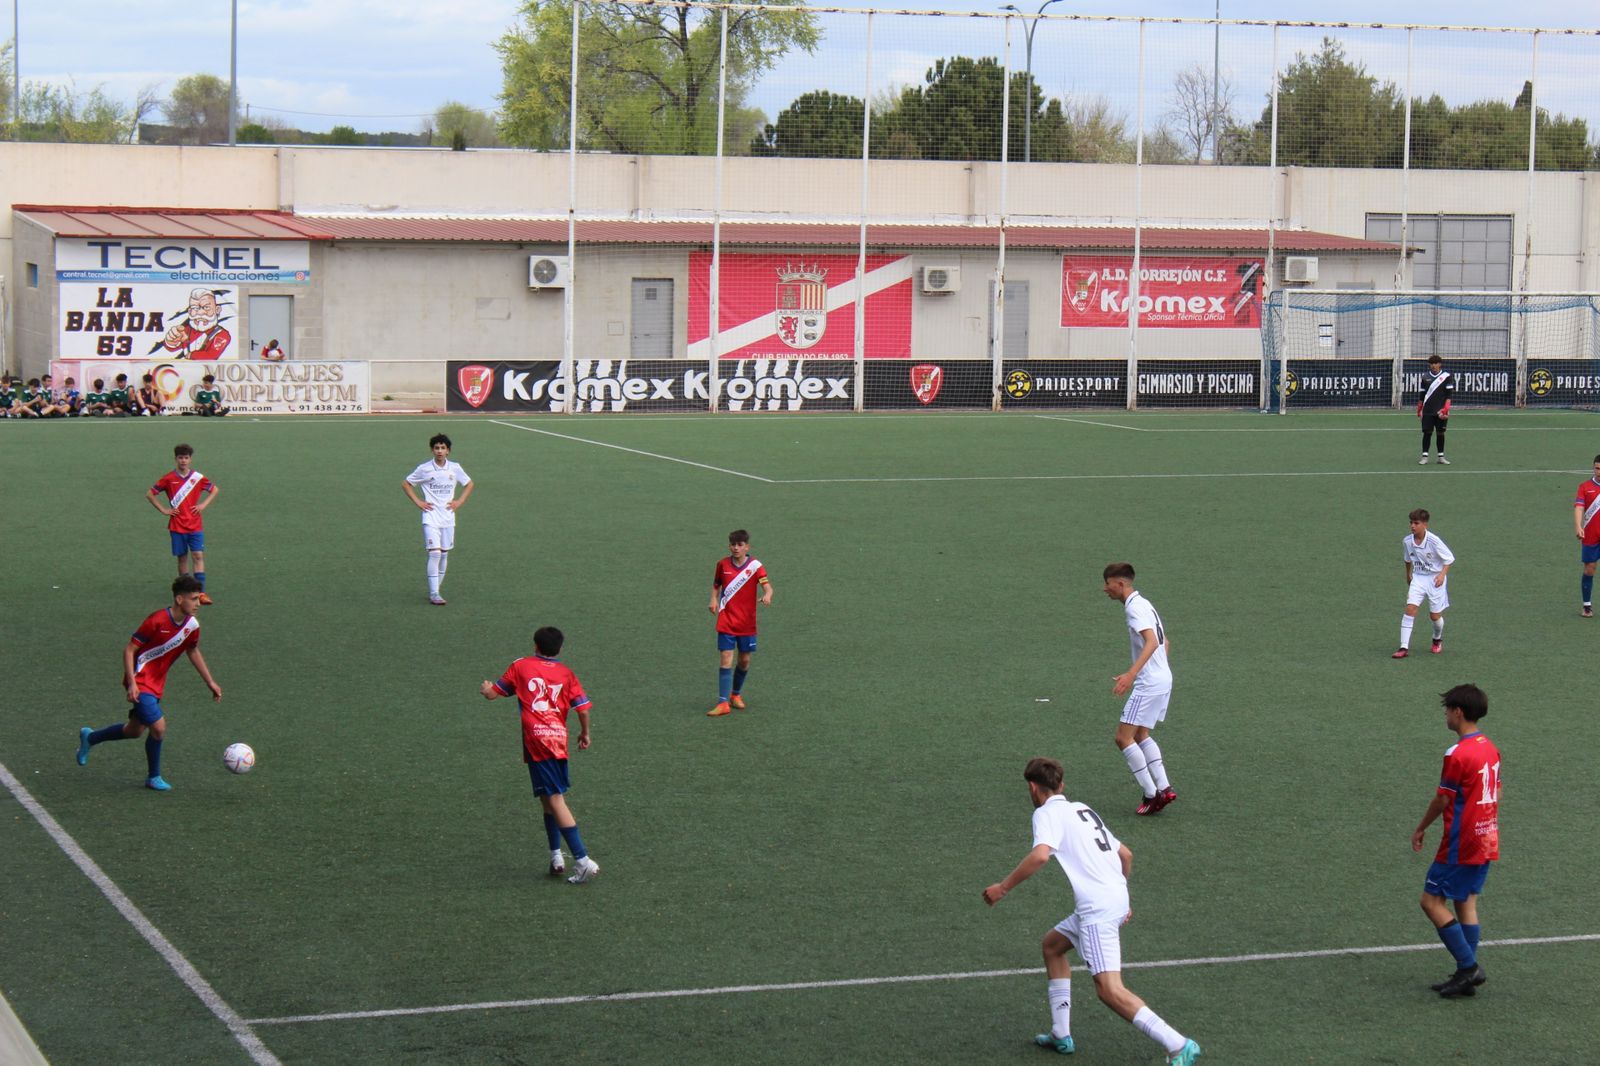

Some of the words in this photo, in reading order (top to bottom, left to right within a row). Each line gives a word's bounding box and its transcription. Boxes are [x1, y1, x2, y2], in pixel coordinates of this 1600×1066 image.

[87, 241, 280, 270] TECNEL
[62, 271, 150, 280] central.tecnel@gmail.com
[170, 270, 280, 281] electrificaciones
[1101, 268, 1128, 281] A.D.
[1131, 266, 1202, 285] ORREJÓN
[1204, 269, 1227, 282] C.F.
[96, 287, 133, 308] LA
[1100, 288, 1226, 313] Kromex
[65, 311, 165, 332] BANDA
[1147, 313, 1176, 323] Sponsor
[96, 335, 133, 356] 53
[203, 364, 344, 382] MONTAJES
[1302, 376, 1382, 390] PAIDESPORT
[1464, 372, 1509, 392] PISCINA
[503, 369, 675, 400] Kromex
[683, 369, 850, 400] Kromex
[1036, 377, 1120, 391] PAIDESPORT
[1138, 373, 1193, 394] GIMNASIO
[1197, 373, 1204, 394] Y
[1208, 373, 1254, 394] PISCINA
[299, 404, 311, 412] 91
[314, 404, 333, 412] 438
[335, 404, 347, 412] 42
[349, 404, 363, 412] 76
[1076, 808, 1113, 853] 3
